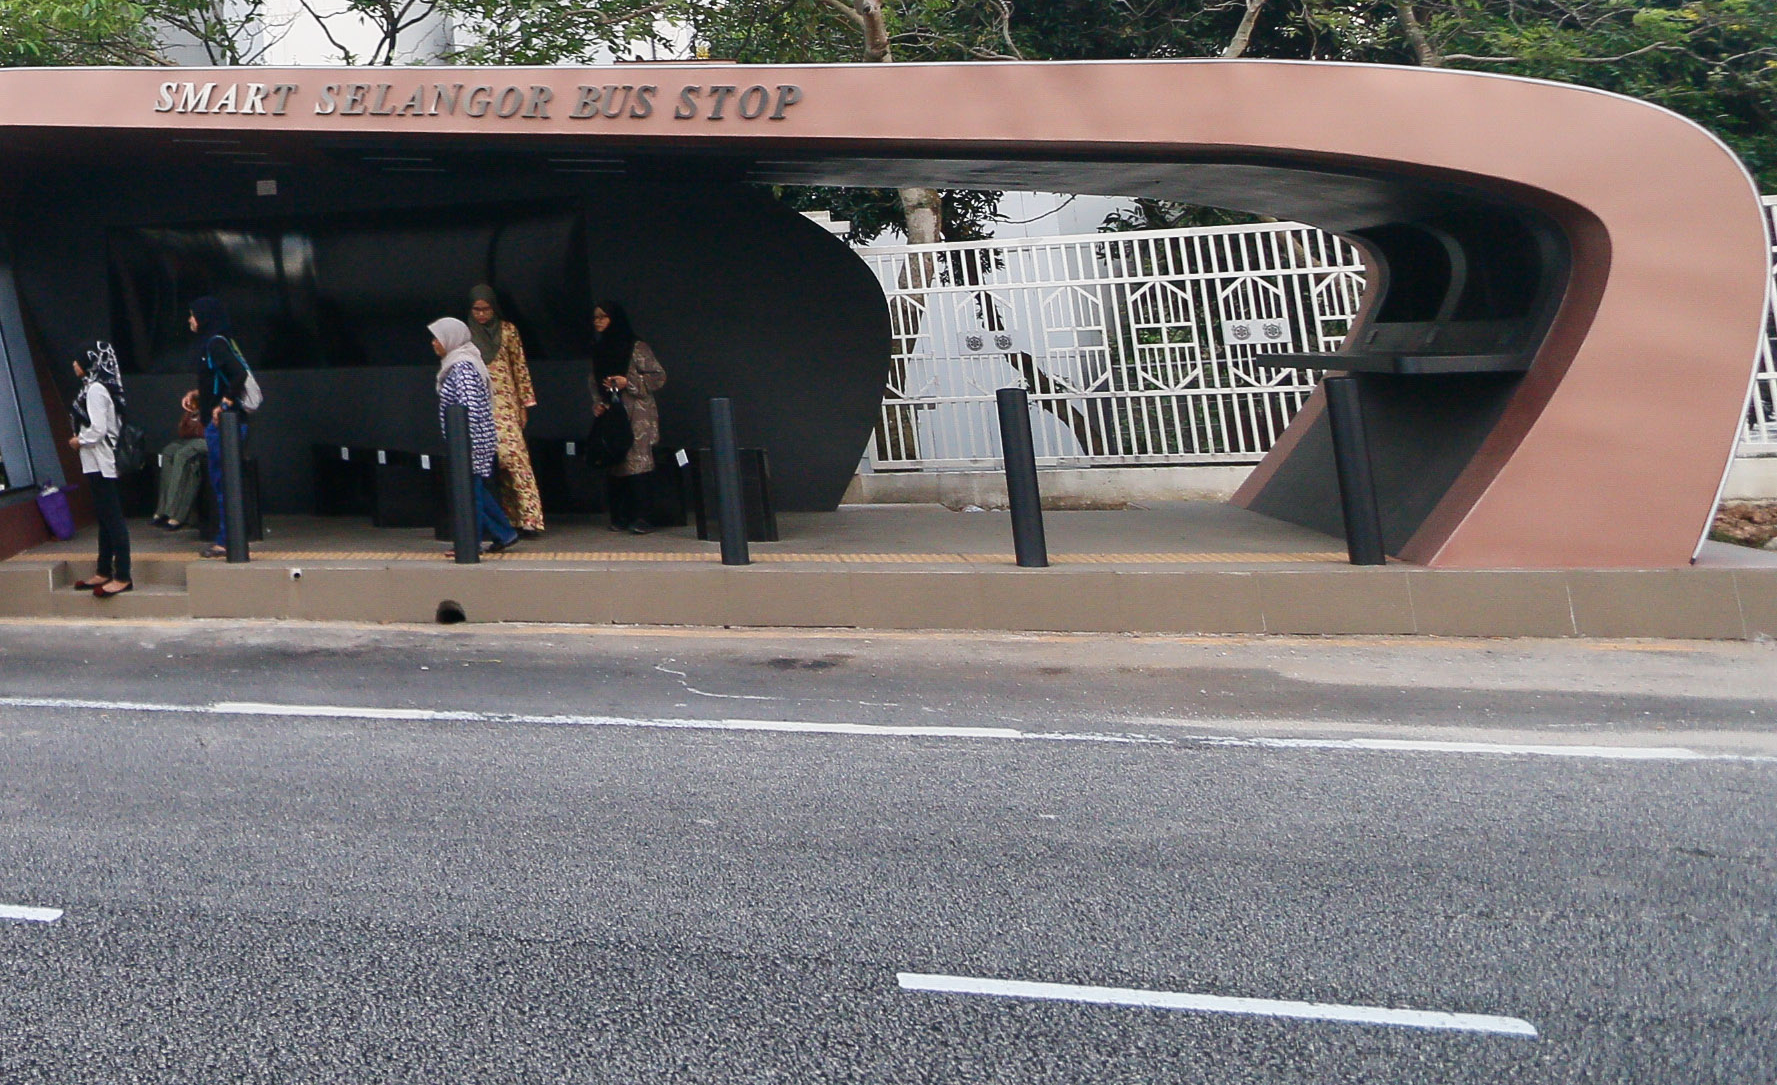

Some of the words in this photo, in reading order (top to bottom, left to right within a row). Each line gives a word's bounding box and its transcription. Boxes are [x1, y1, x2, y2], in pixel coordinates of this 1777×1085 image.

[154, 82, 297, 116] SMART
[314, 83, 553, 118] SELANGOR
[569, 85, 657, 120] BUS
[674, 85, 803, 120] STOP
